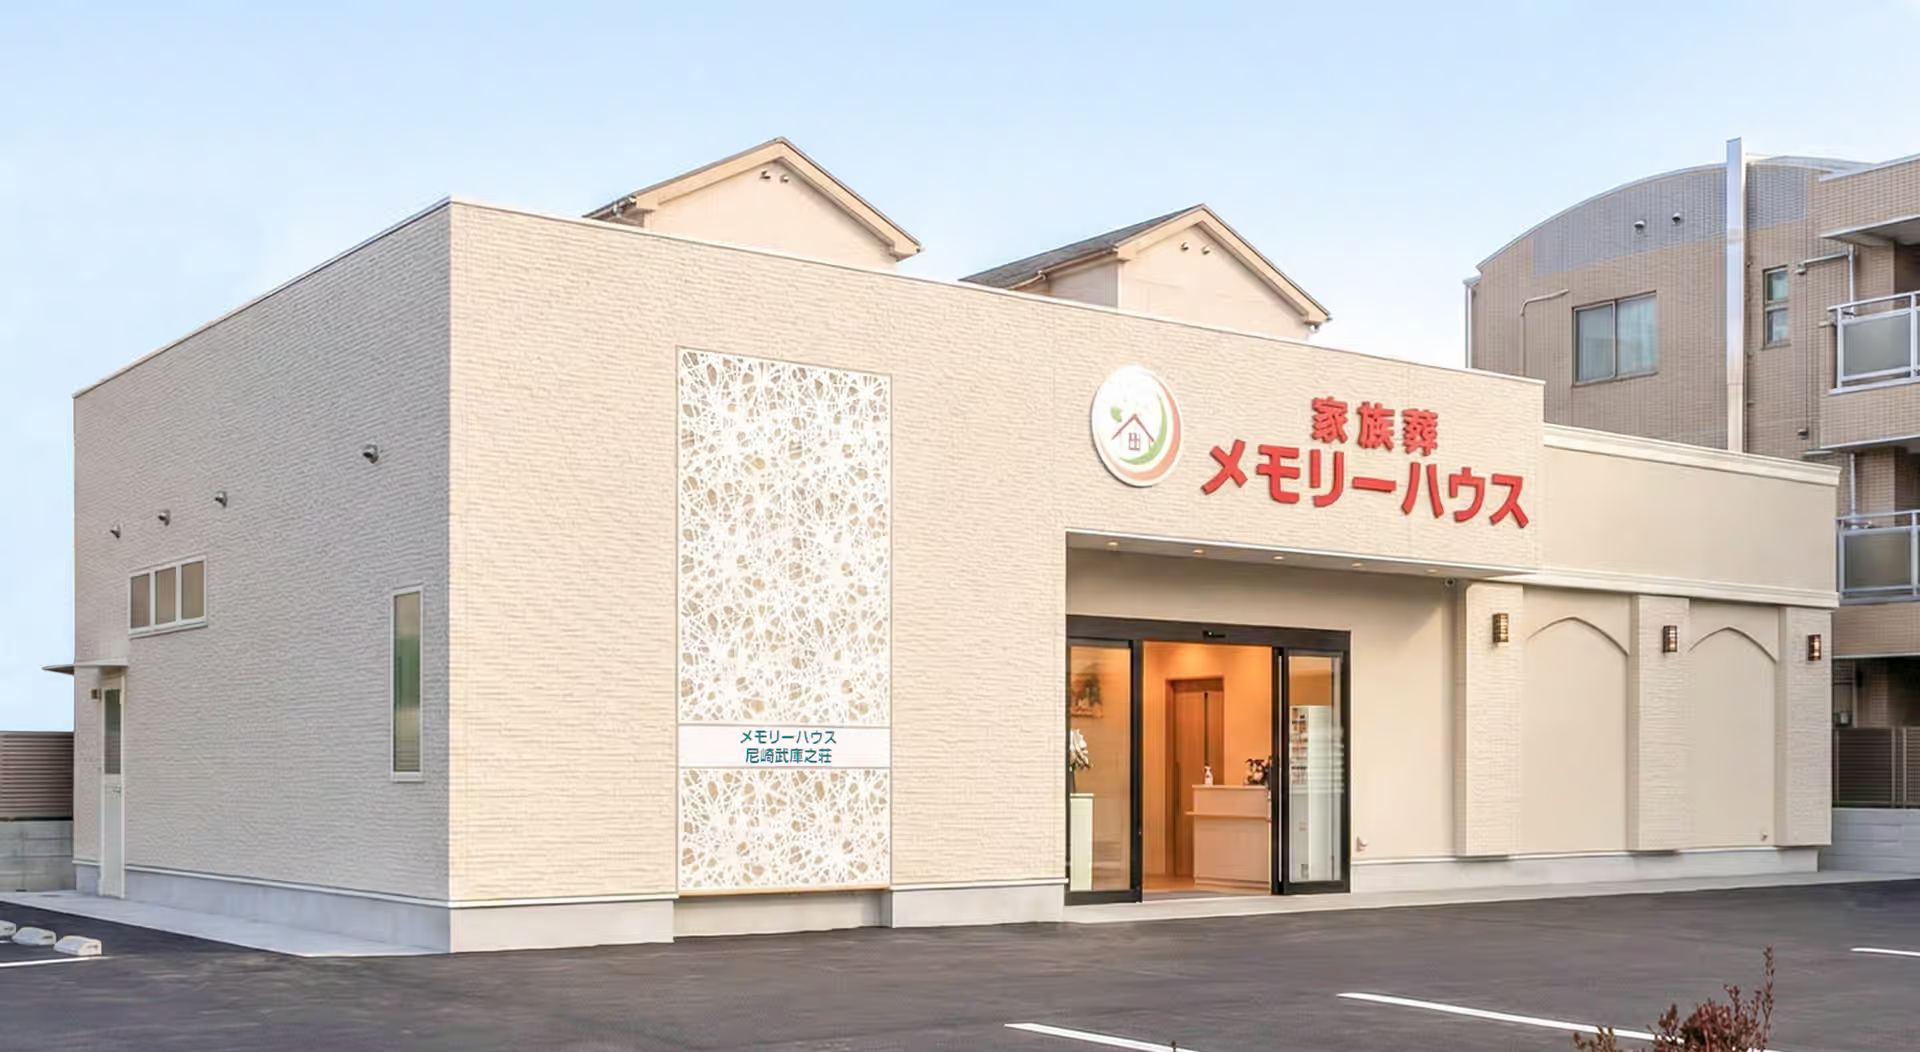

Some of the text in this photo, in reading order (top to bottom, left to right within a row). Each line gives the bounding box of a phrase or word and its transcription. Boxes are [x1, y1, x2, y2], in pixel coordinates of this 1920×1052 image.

[1311, 396, 1439, 457] 家族葬
[1201, 438, 1529, 528] メモリーハウス
[740, 730, 837, 745] メモリーハウス
[745, 747, 832, 764] 尼崎武庫之荘
